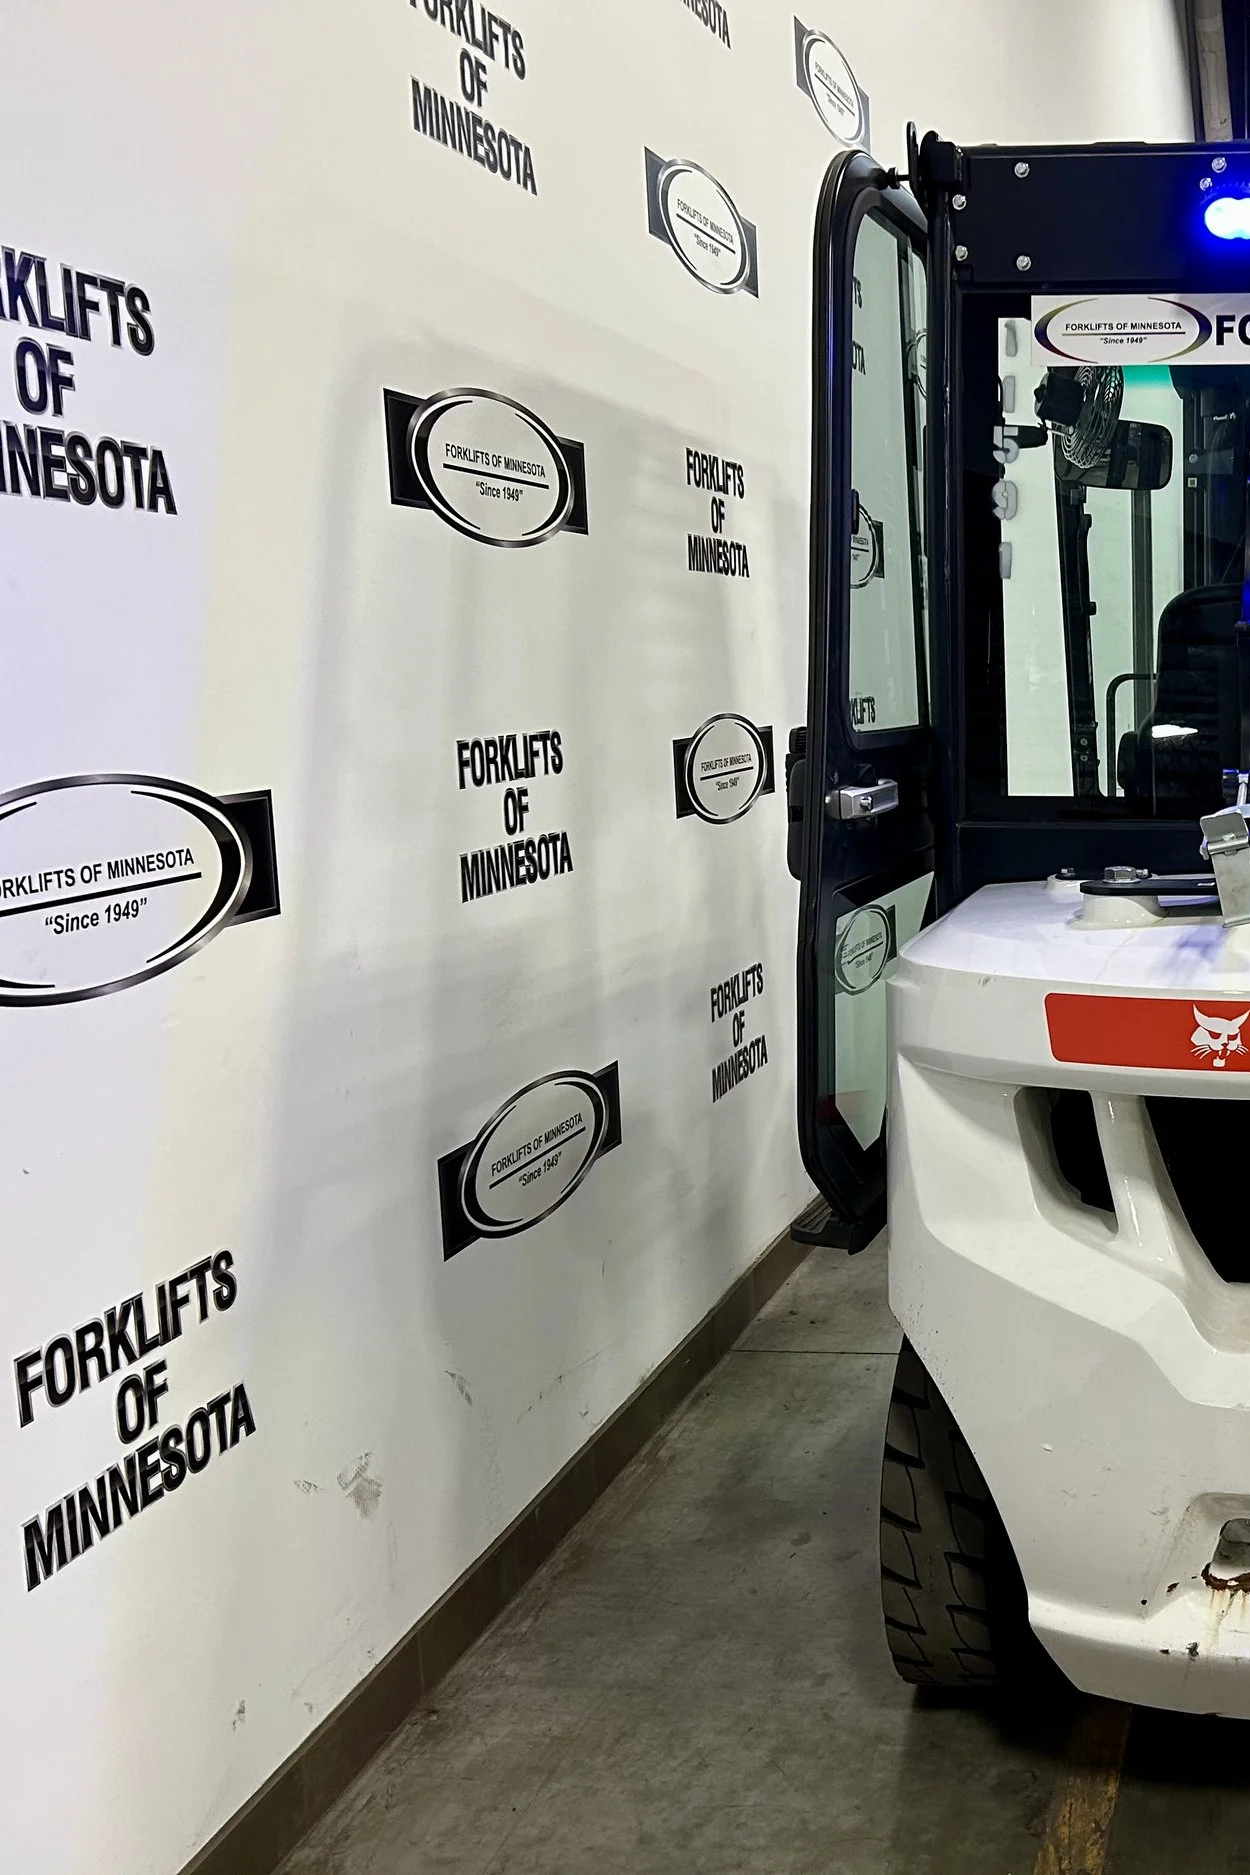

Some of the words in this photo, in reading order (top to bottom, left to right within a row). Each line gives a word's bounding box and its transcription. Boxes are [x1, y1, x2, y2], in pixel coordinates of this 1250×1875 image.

[410, 0, 526, 80] RKLIFTS
[460, 48, 488, 107] OF
[410, 75, 538, 196] MINNESOTA
[0, 246, 155, 356] KLIFTS
[1065, 323, 1114, 331] FORKLIFTS
[1116, 322, 1128, 331] OF
[1130, 321, 1182, 330] MINNESOTA
[14, 336, 75, 416] OF
[0, 420, 178, 515] NESOTA
[445, 443, 490, 466] FORKLIFTS
[491, 454, 502, 468] OF
[503, 456, 546, 478] MINNESOTA
[685, 446, 745, 499] FORKLIFTS
[710, 497, 725, 534] OF
[687, 533, 750, 578] MINNESOTA
[456, 729, 564, 790] FORKLIFTS
[503, 787, 529, 836] OF
[0, 868, 76, 899] RKLIFTS
[80, 863, 102, 885] OF
[107, 848, 194, 879] MINNESOTA
[459, 830, 574, 904] MINNESOTA
[45, 910, 99, 935] “Since
[104, 897, 148, 924] 1949”
[710, 962, 763, 1023] FORKLIFTS
[732, 1009, 745, 1048] OF
[712, 1035, 768, 1103] MINNESOTA
[491, 1143, 532, 1176] FORKLIFTS
[533, 1134, 543, 1150] OF
[544, 1112, 582, 1144] MINNESOTA
[14, 1249, 237, 1428] FORKLIFTS
[115, 1358, 169, 1444] OF
[20, 1379, 256, 1593] MINNESOTA
